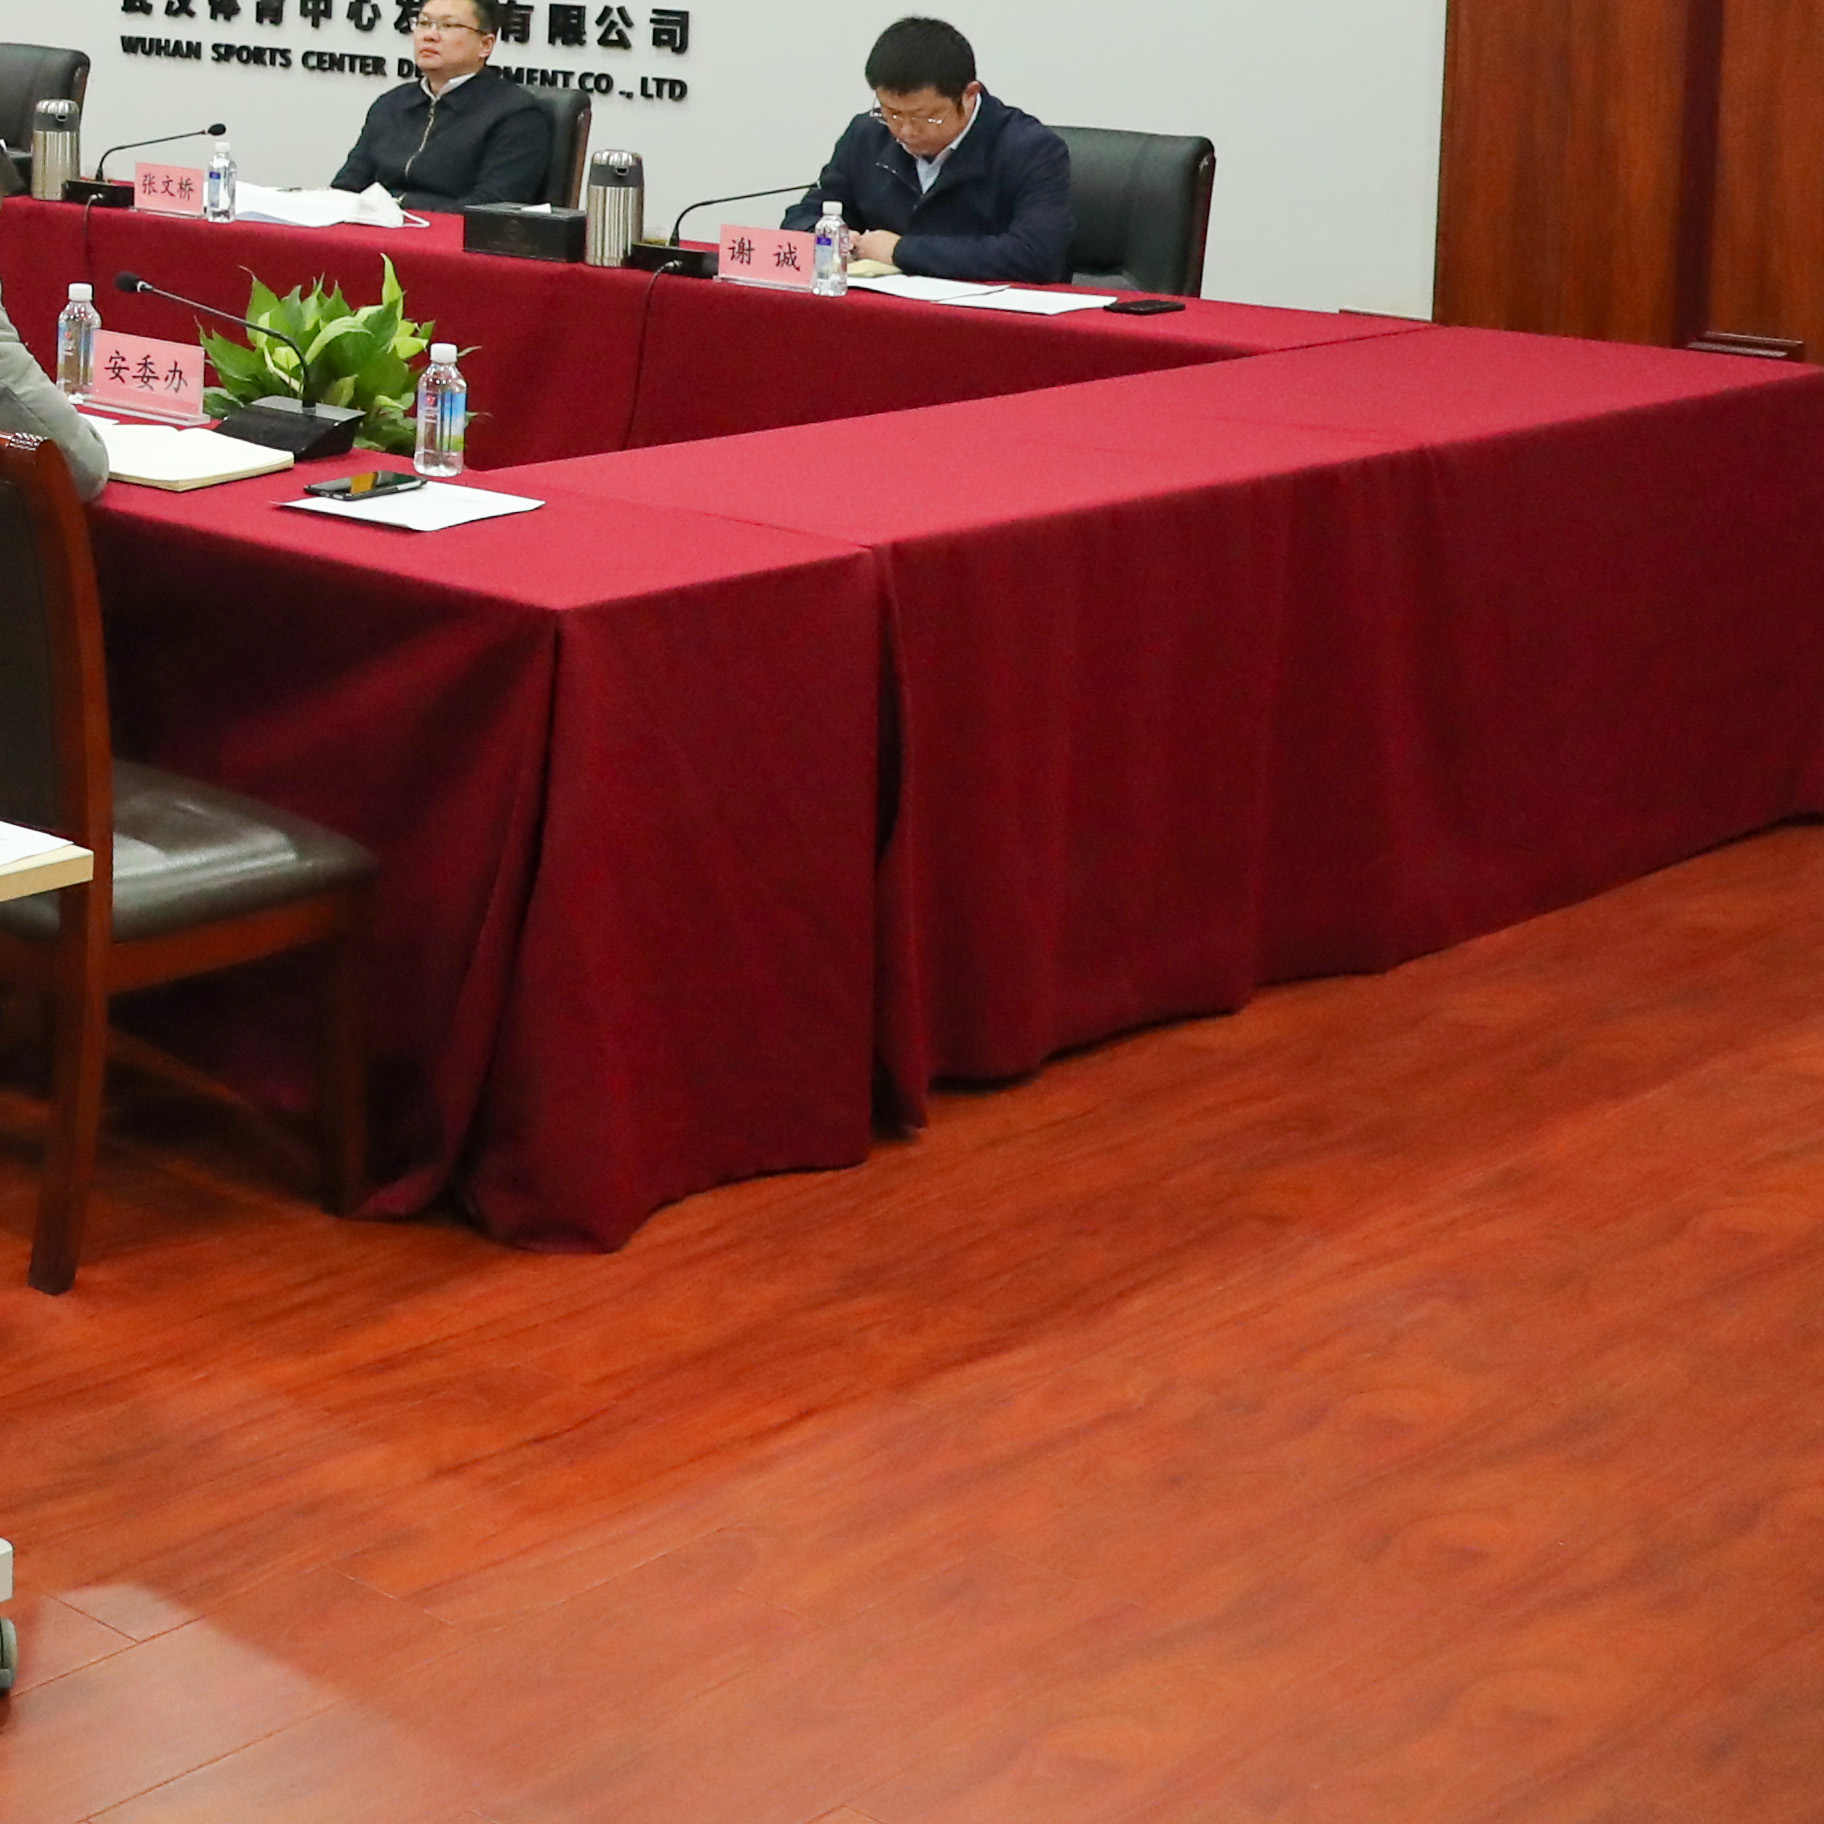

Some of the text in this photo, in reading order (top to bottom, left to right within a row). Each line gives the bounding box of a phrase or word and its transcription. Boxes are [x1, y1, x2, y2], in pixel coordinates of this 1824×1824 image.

[120, 35, 202, 61] WUHAN
[211, 42, 292, 69] SPORTS
[301, 50, 387, 77] CENTER
[640, 76, 688, 102] LTD
[141, 173, 196, 201] 张文桥
[104, 349, 189, 394] 安委办
